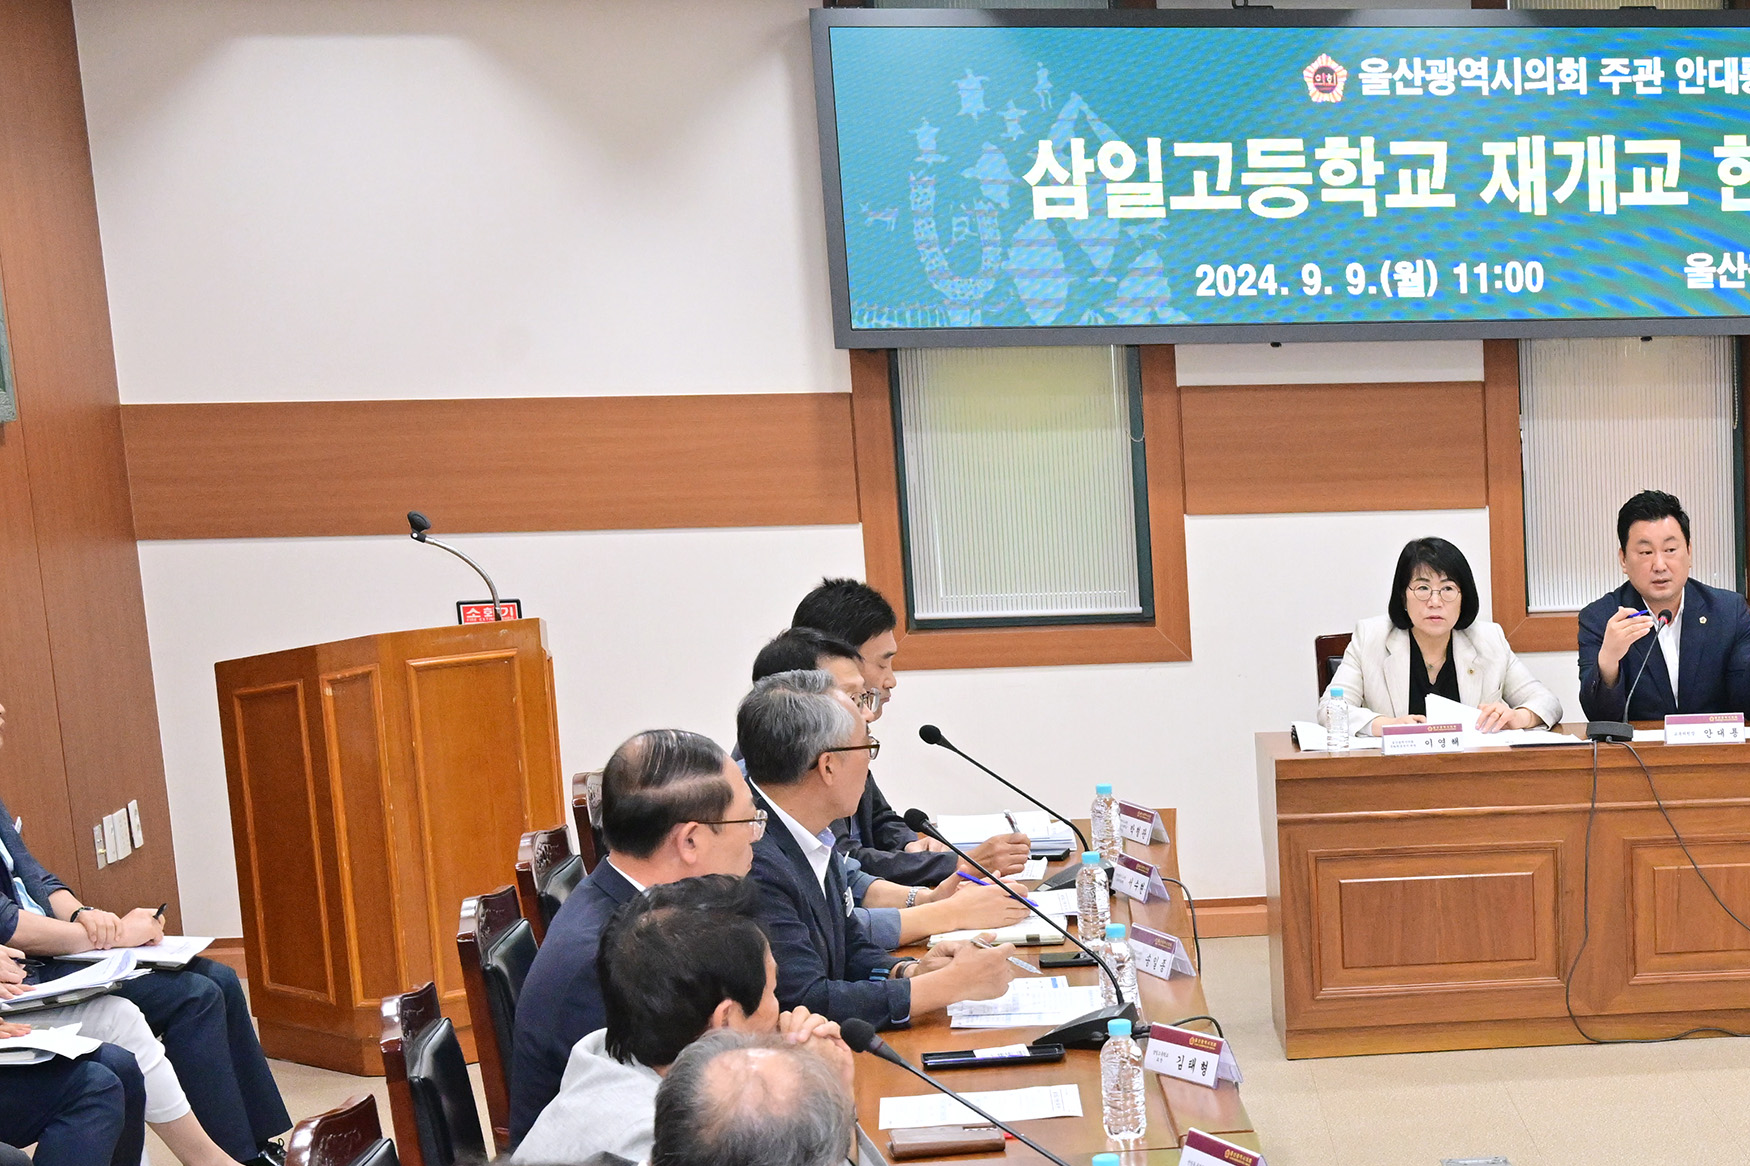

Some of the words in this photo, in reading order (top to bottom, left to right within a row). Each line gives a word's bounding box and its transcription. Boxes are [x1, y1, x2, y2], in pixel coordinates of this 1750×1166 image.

[1358, 56, 1587, 96] 울산광역시의회
[1599, 56, 1665, 95] 주관
[1022, 136, 1456, 220] 삼일고등학교
[1479, 134, 1689, 216] 재개교
[1195, 263, 1289, 297] 2024.
[1301, 263, 1333, 296] 9.
[1345, 259, 1438, 298] 9.(월)
[1453, 261, 1544, 294] 11:00
[466, 606, 514, 618] 소화기
[1176, 1054, 1209, 1077] 김태형
